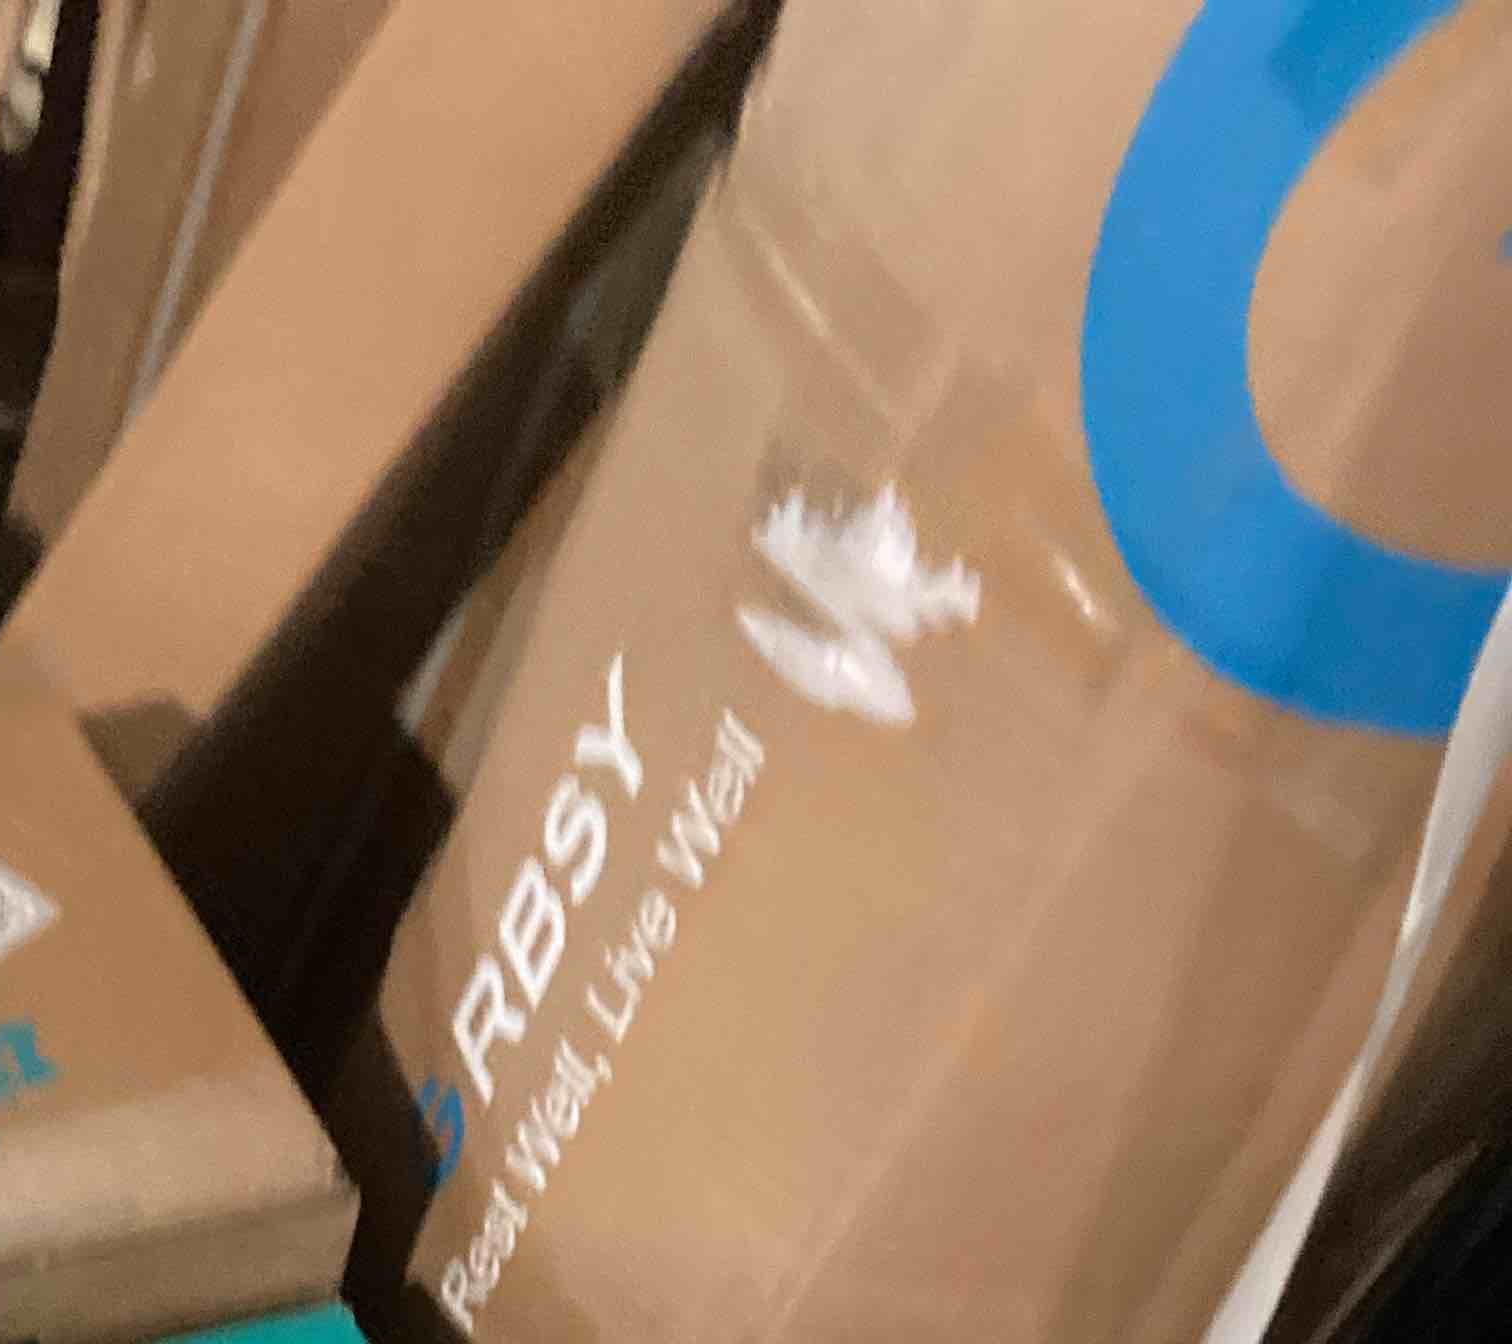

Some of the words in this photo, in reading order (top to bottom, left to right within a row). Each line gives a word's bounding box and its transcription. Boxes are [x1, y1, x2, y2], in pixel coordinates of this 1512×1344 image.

[441, 1180, 528, 1335] Rest
[505, 1036, 613, 1194] Well,
[586, 889, 678, 1045] Live
[656, 707, 767, 889] Well
